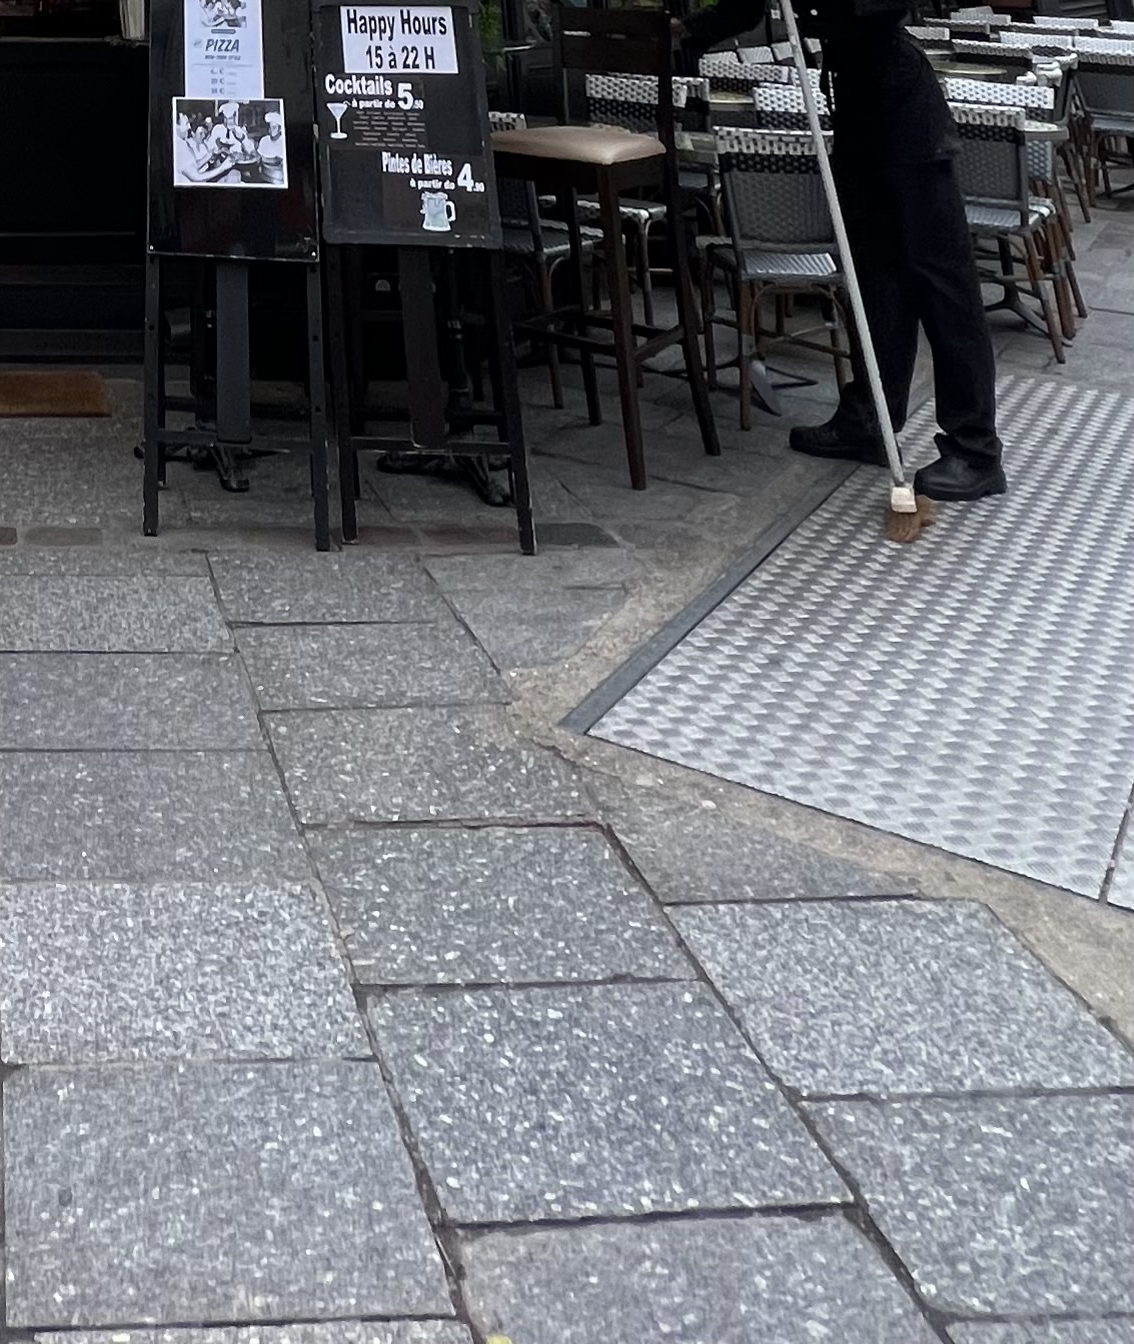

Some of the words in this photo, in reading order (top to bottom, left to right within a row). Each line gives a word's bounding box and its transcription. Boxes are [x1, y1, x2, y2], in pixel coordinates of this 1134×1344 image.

[346, 8, 395, 41] Happy
[399, 8, 447, 35] Hours
[205, 38, 240, 52] PIZZA
[366, 45, 383, 69] 15
[387, 45, 397, 69] à
[401, 45, 420, 69] 22
[424, 46, 436, 69] H
[325, 74, 393, 96] Cocktails
[359, 99, 383, 110] partir
[382, 151, 410, 174] Pintes
[411, 153, 423, 174] de
[423, 153, 453, 176] Bières
[417, 179, 442, 190] partir
